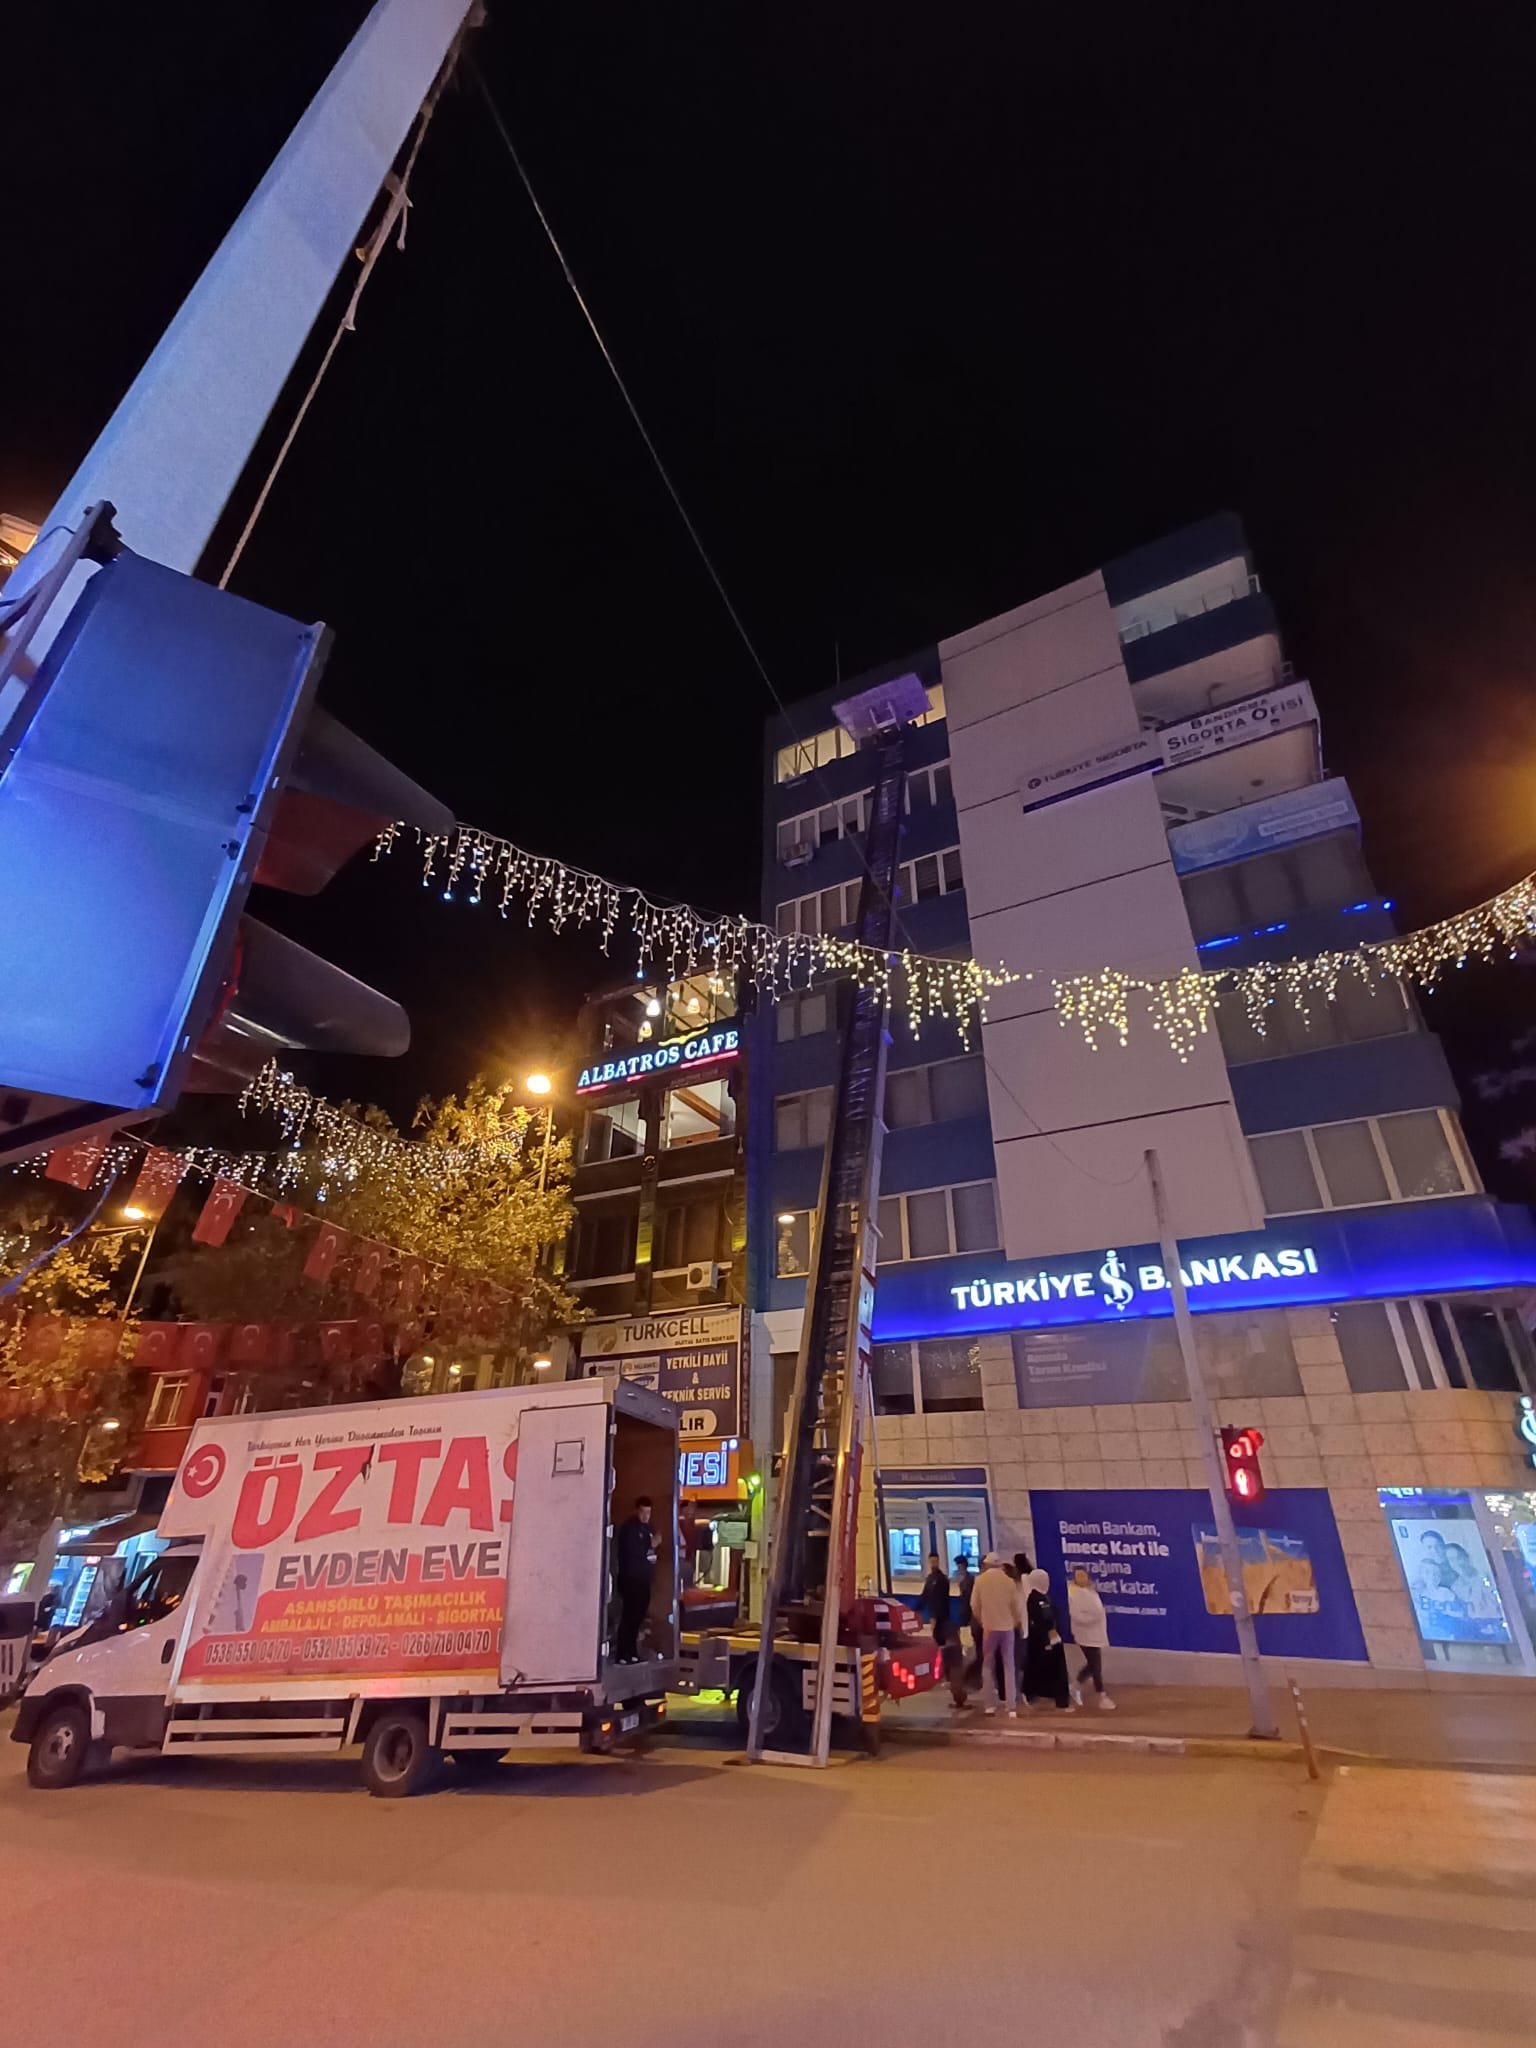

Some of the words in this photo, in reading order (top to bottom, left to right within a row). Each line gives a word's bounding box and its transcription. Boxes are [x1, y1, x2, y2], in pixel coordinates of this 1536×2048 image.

[578, 1046, 680, 1087] ALBATROS
[684, 1031, 739, 1060] CAFE
[951, 1271, 1095, 1310] TÜRKİYE
[623, 1317, 710, 1343] TURKCELL
[666, 1351, 700, 1370] YETKİLİ
[697, 1384, 731, 1400] SERVİS
[1059, 1520, 1100, 1534] Benim
[1102, 1521, 1160, 1537] Bankam,
[1110, 1540, 1146, 1556] Kart
[1147, 1541, 1169, 1556] ile
[275, 1547, 409, 1591] EVDEN
[421, 1541, 502, 1582] EVE
[1120, 1579, 1159, 1595] katar.
[283, 1594, 379, 1616] ASANSÖRLÜ
[384, 1591, 488, 1611] TAŞIMACILIK
[261, 1614, 332, 1632] AMBALAJLI
[343, 1611, 425, 1630] DEPOLAMALI
[456, 1630, 472, 1652] 04
[475, 1629, 491, 1651] 70
